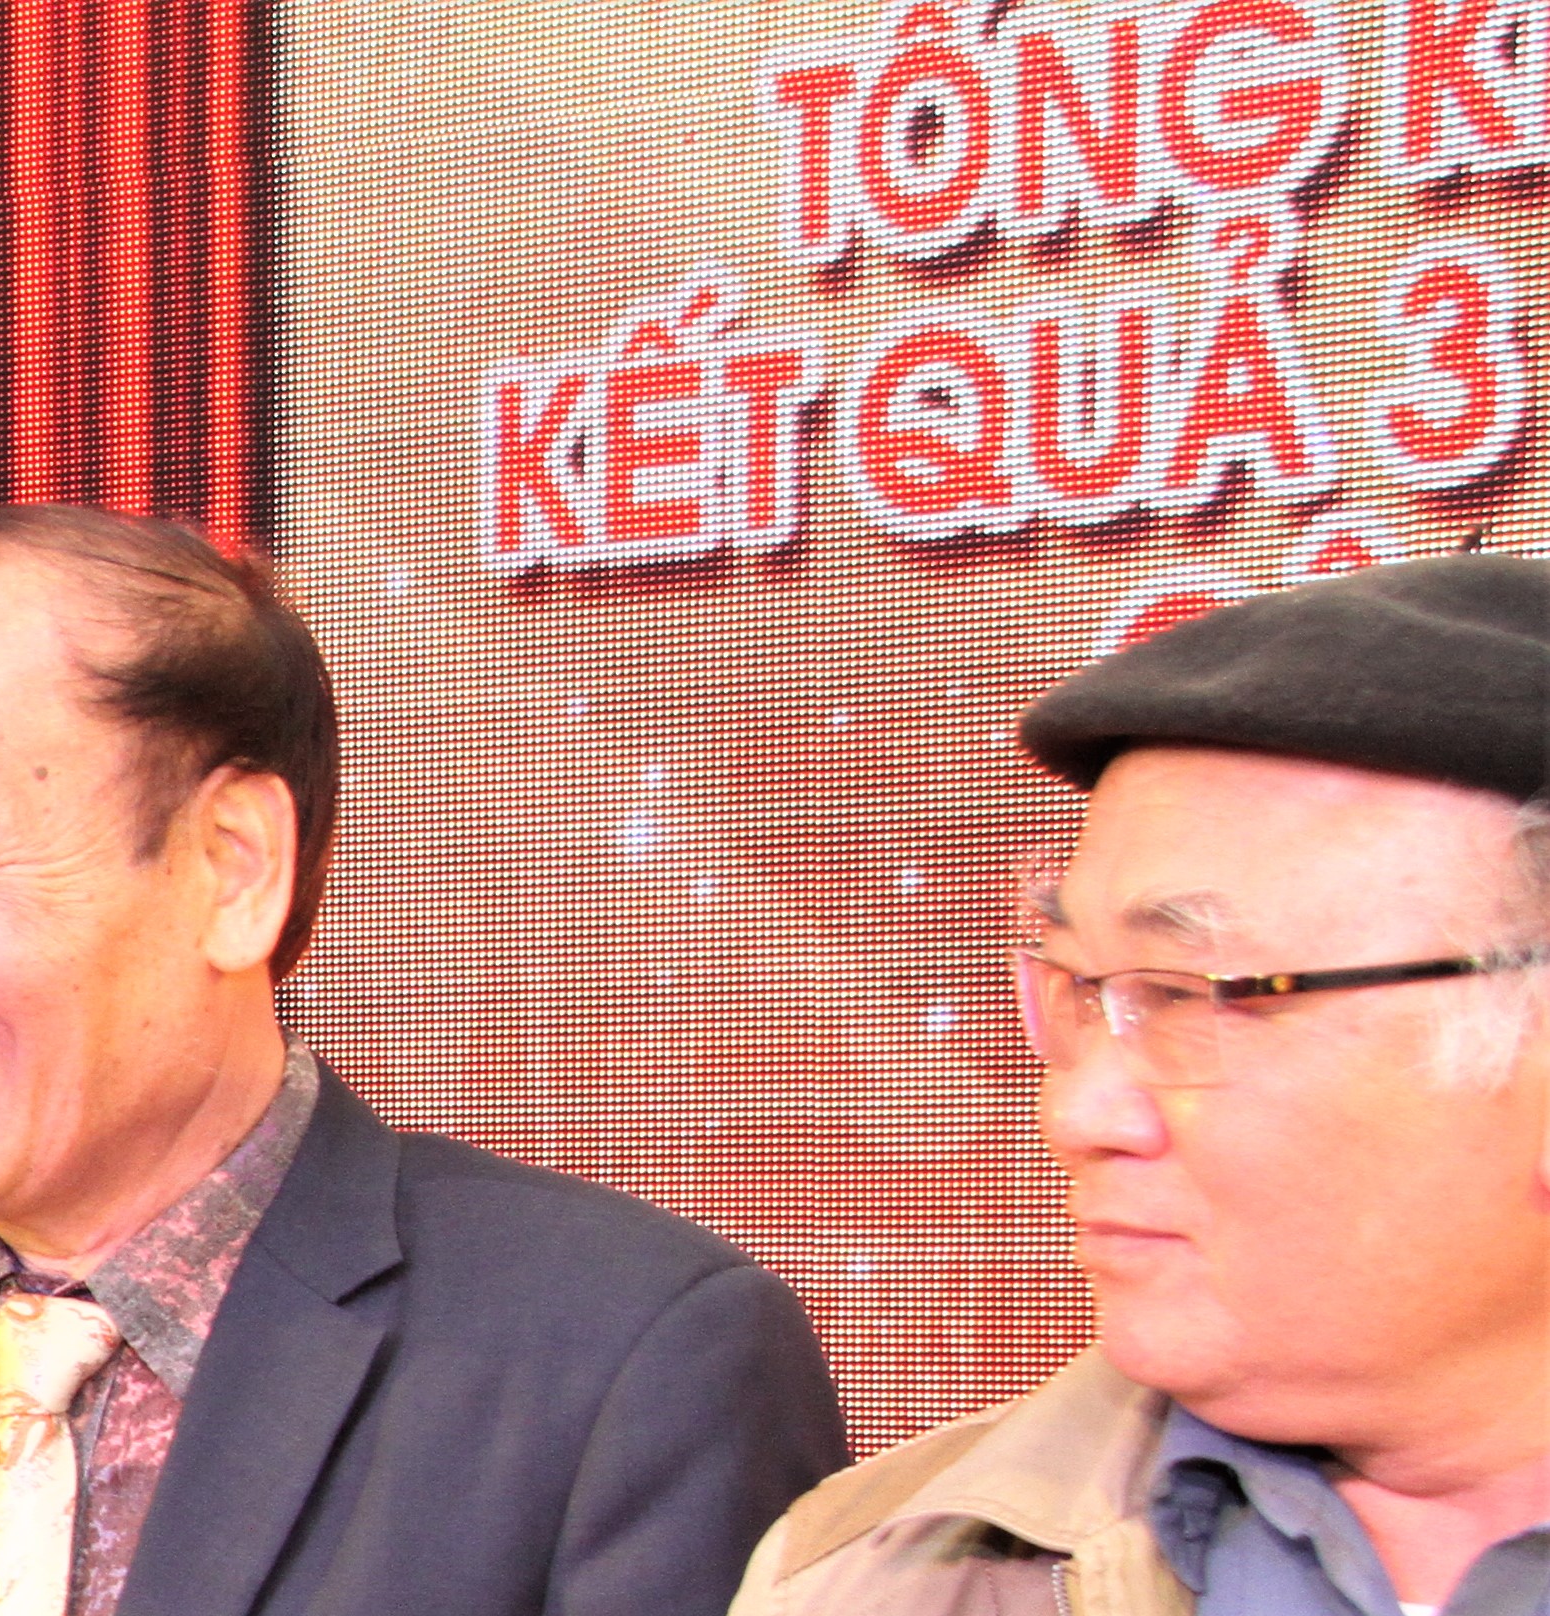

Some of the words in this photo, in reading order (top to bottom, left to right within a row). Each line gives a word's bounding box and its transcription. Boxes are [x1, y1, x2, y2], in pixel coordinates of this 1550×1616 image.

[491, 284, 804, 553] KẾT
[855, 214, 1315, 515] QUẢ
[1385, 254, 1501, 466] 3
